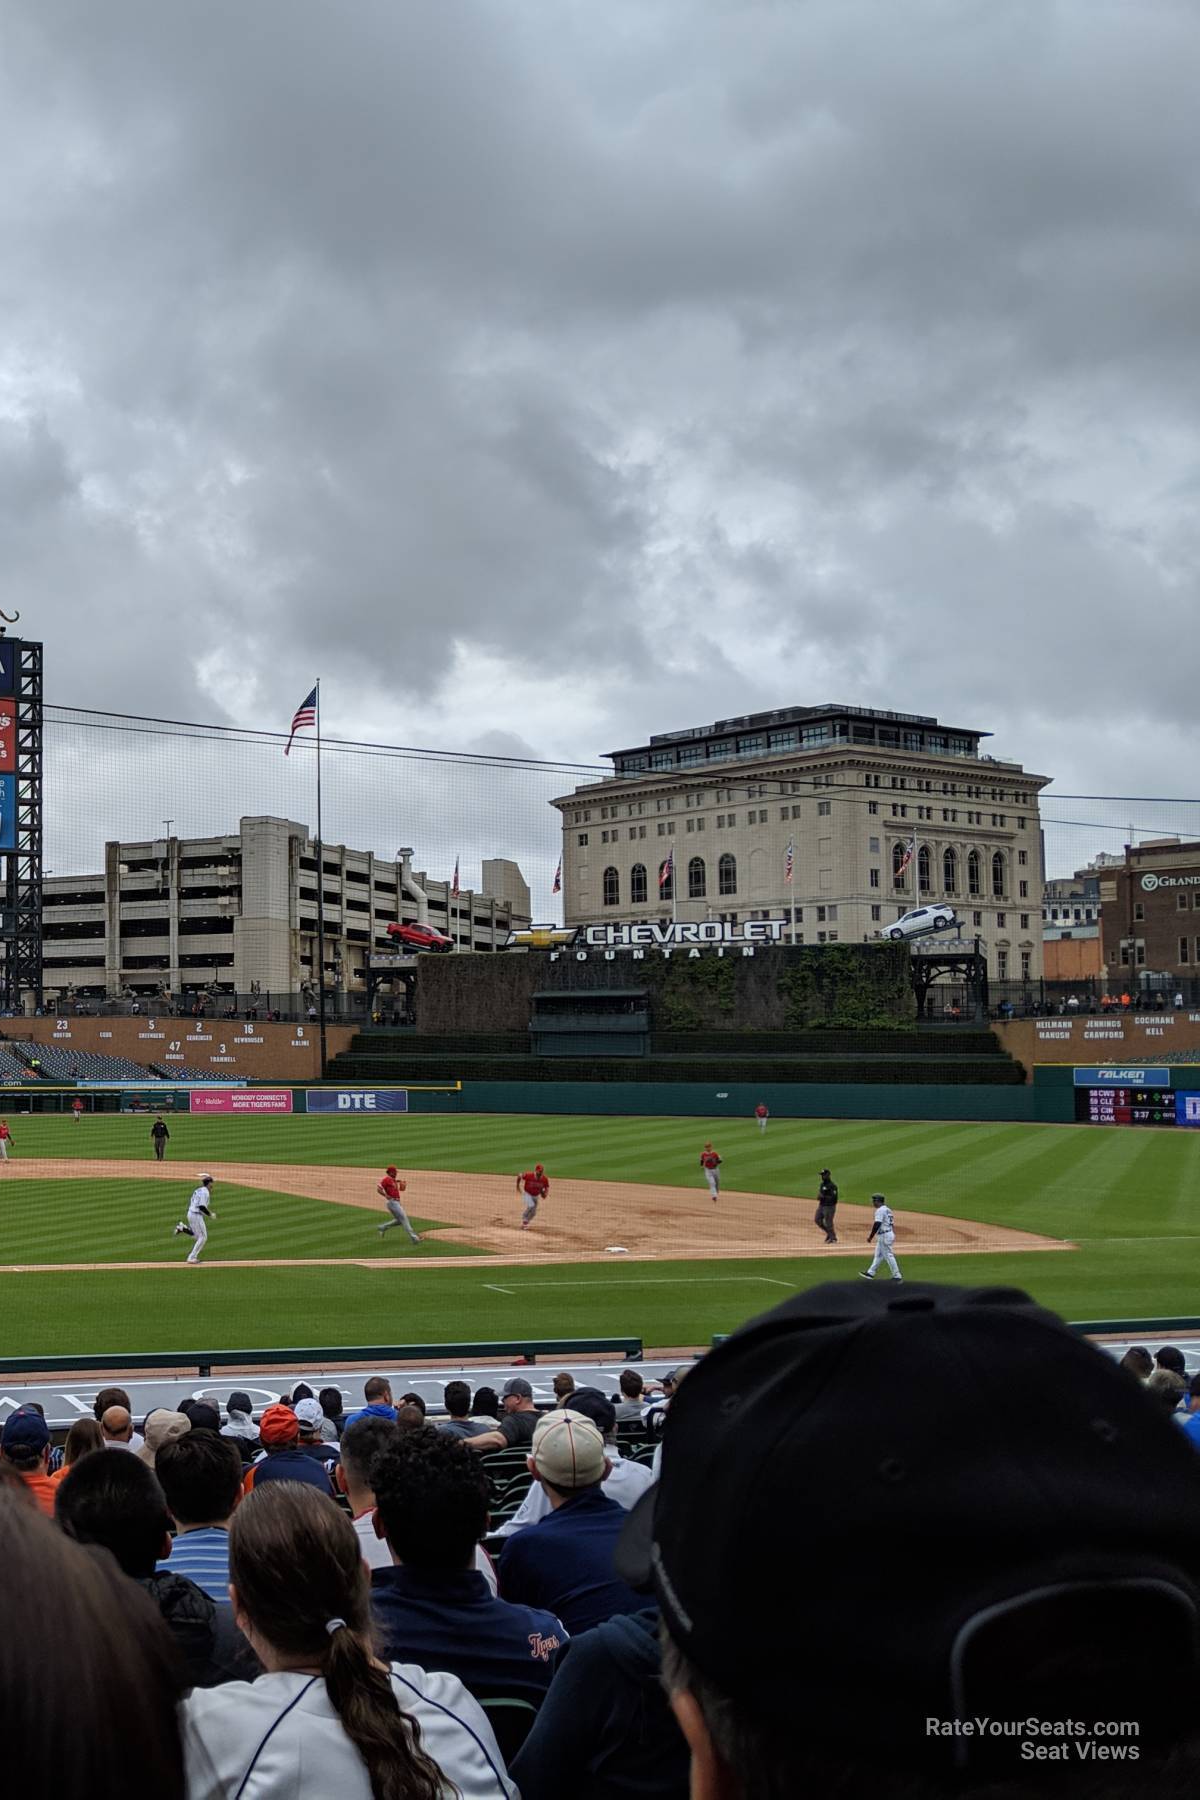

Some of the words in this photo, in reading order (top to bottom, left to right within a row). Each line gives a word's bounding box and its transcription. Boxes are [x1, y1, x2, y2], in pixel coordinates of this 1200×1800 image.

[586, 919, 789, 945] CHEVROLET
[550, 947, 755, 962] FOUNTAIN
[56, 1020, 68, 1030] 23
[148, 1020, 155, 1030] 5
[1036, 1021, 1073, 1029] HEILMANN
[1085, 1020, 1121, 1028] JENNINGS
[1135, 1017, 1174, 1025] COCHRANE
[196, 1022, 202, 1032] 2
[244, 1024, 254, 1034] 16
[297, 1027, 303, 1037] 6
[169, 1042, 180, 1051] 47
[220, 1044, 226, 1053] 3
[338, 1094, 376, 1108] DTE
[528, 1632, 559, 1662] Tigers
